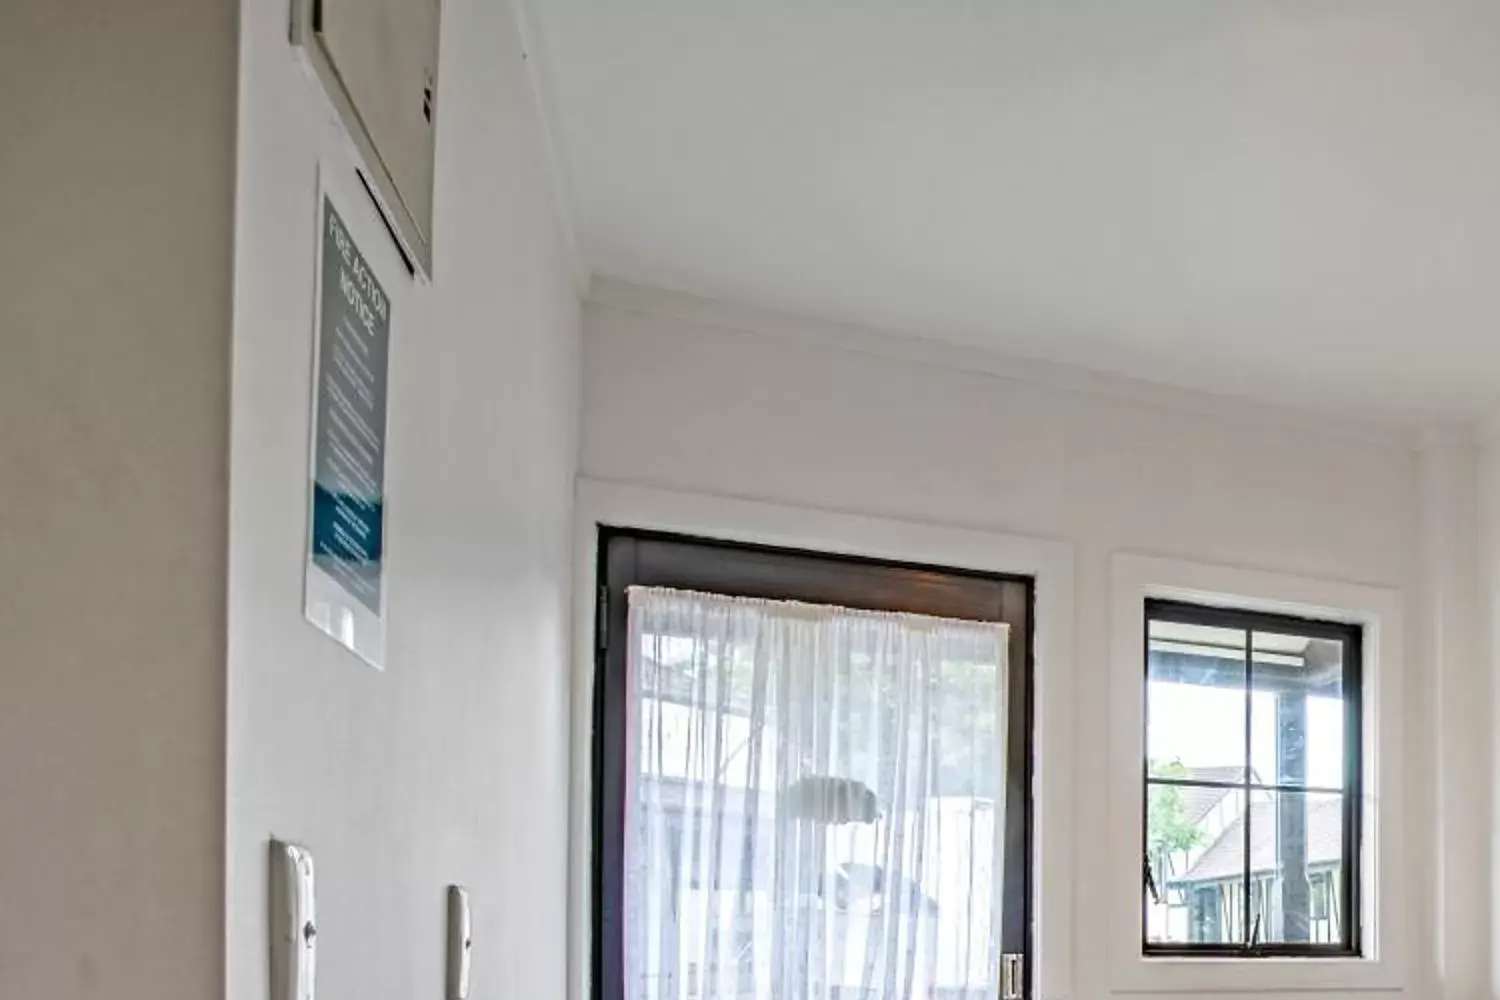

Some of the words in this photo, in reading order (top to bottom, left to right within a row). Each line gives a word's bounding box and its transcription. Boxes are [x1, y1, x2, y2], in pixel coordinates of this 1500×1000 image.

[329, 214, 351, 265] FIRE
[353, 257, 387, 321] ACTION
[339, 266, 375, 337] NOTICE
